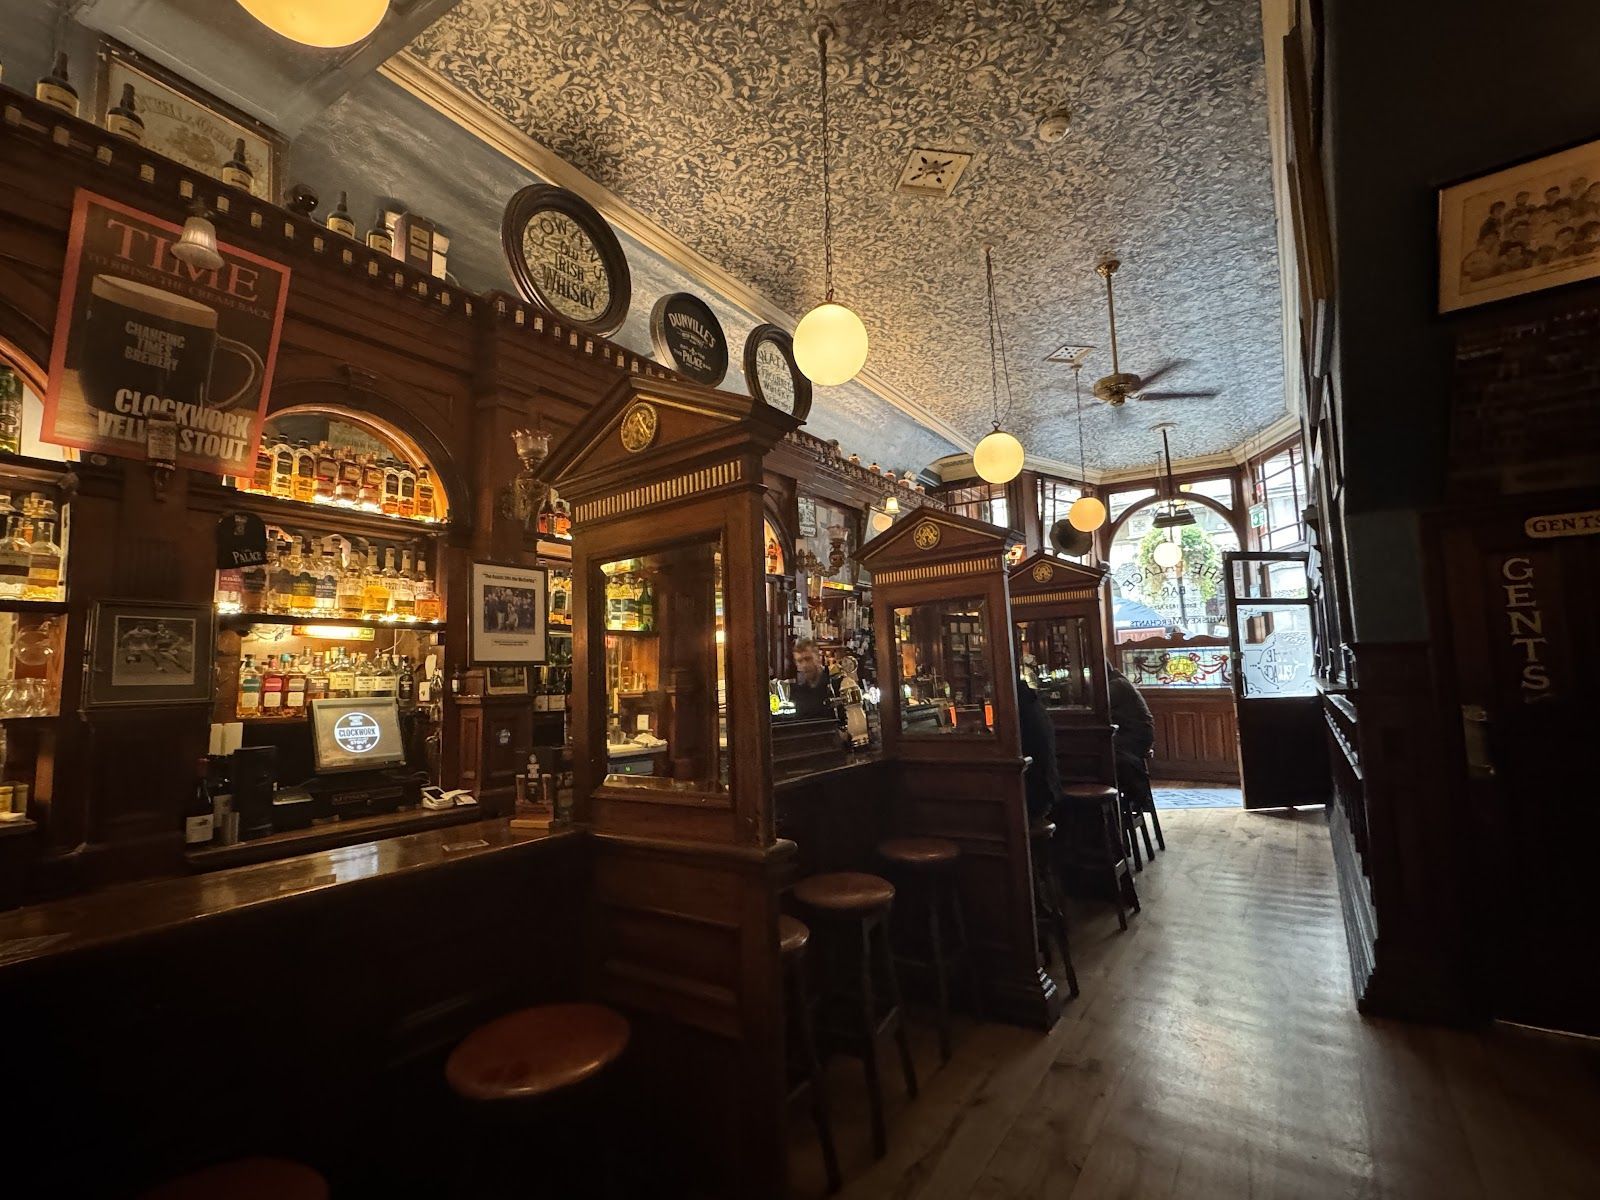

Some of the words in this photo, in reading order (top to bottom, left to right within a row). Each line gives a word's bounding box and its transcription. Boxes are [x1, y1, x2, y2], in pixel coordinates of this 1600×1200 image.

[107, 218, 259, 302] TIME
[555, 251, 584, 283] IRISH
[238, 300, 272, 321] BACK
[125, 320, 186, 349] CHANGING
[137, 336, 173, 358] TIMES
[125, 345, 179, 372] BREWERY
[115, 388, 251, 440] CLOCKWORK
[178, 428, 248, 463] STOUT
[1501, 557, 1551, 691] GENTS
[338, 728, 376, 738] CLOCKWORK
